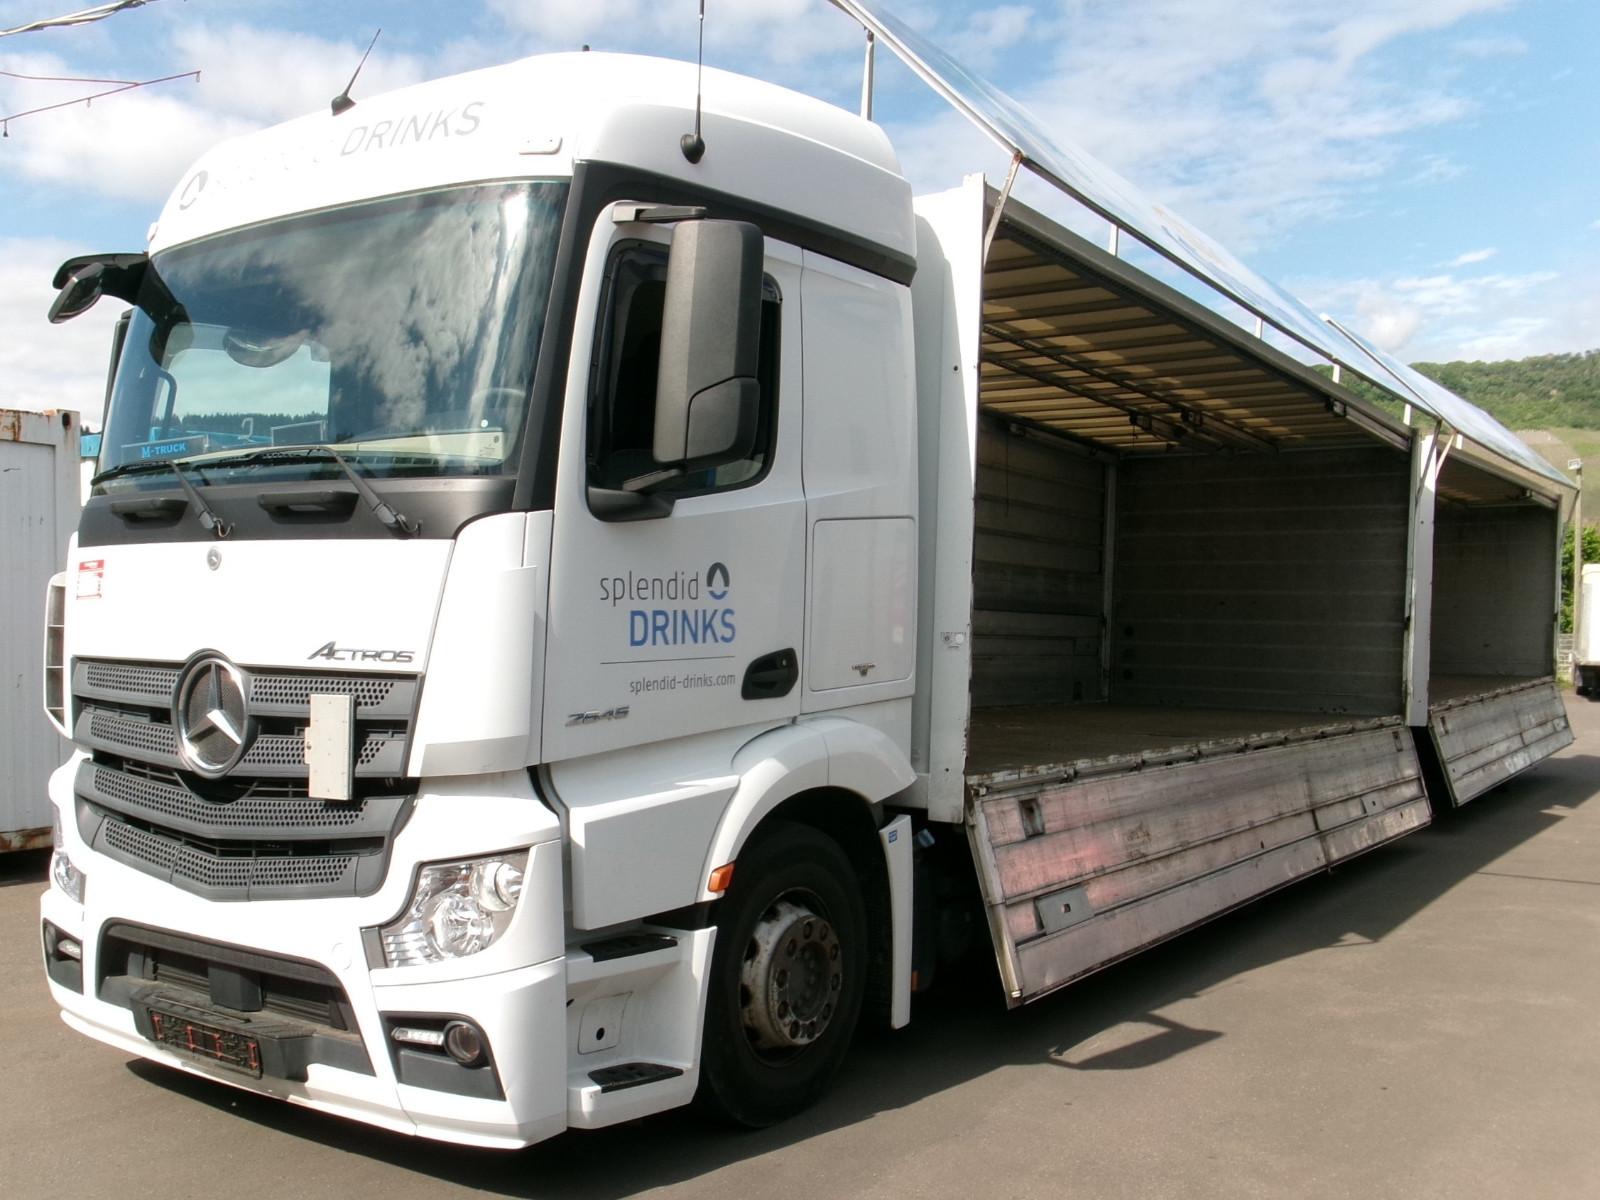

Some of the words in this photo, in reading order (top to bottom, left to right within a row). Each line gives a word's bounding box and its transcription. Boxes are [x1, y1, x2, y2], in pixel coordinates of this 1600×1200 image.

[340, 101, 485, 157] DRINKS
[141, 442, 187, 459] M-TRUCK
[600, 570, 699, 607] splendid
[630, 608, 736, 647] DRINKS
[629, 673, 736, 696] splendid-drinks.com
